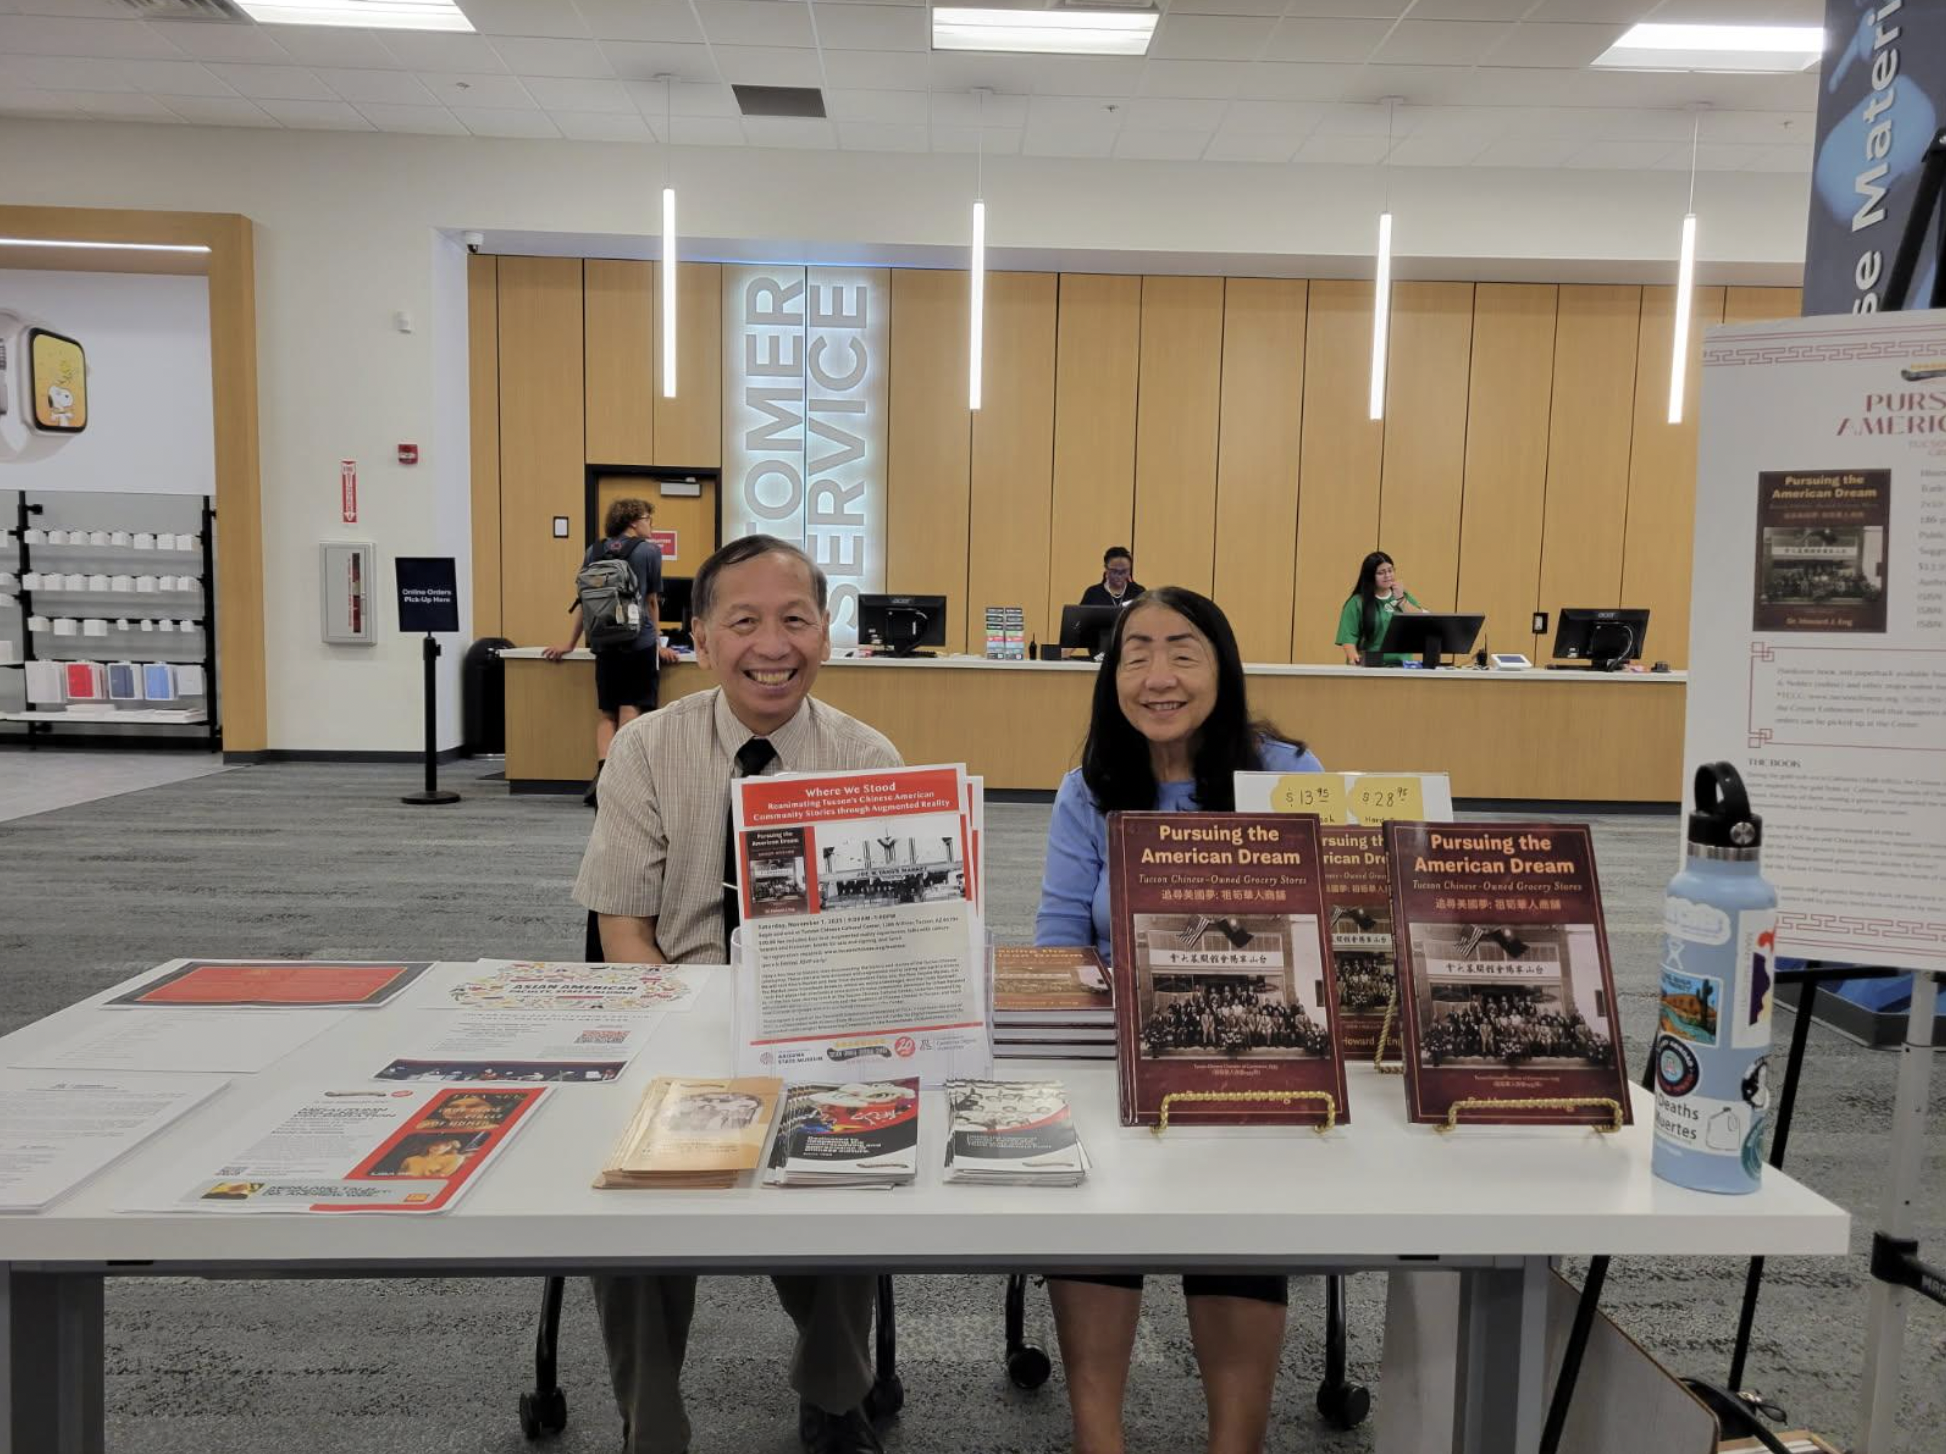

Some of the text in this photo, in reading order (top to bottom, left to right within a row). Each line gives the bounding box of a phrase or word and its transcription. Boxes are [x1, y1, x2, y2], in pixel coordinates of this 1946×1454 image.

[808, 284, 868, 630] SERVICE
[1785, 475, 1865, 487] Pursuing the
[1773, 488, 1877, 499] American Dream
[805, 782, 896, 798] Where We Stood
[768, 791, 935, 811] Reanimating Tucson's Chinese American
[753, 799, 951, 822] Community Stories through Augmented Reality
[1159, 825, 1279, 845] Pursuing the
[1431, 834, 1551, 854] Pursuing the
[1141, 849, 1300, 865] American Dream
[1415, 857, 1575, 874] American Dream
[1139, 874, 1168, 884] Tucson
[1244, 874, 1277, 886] Grocery
[1280, 876, 1307, 885] Stores
[1413, 879, 1441, 890] Tucson
[1516, 881, 1550, 893] Grocery
[1554, 881, 1583, 891] Stores
